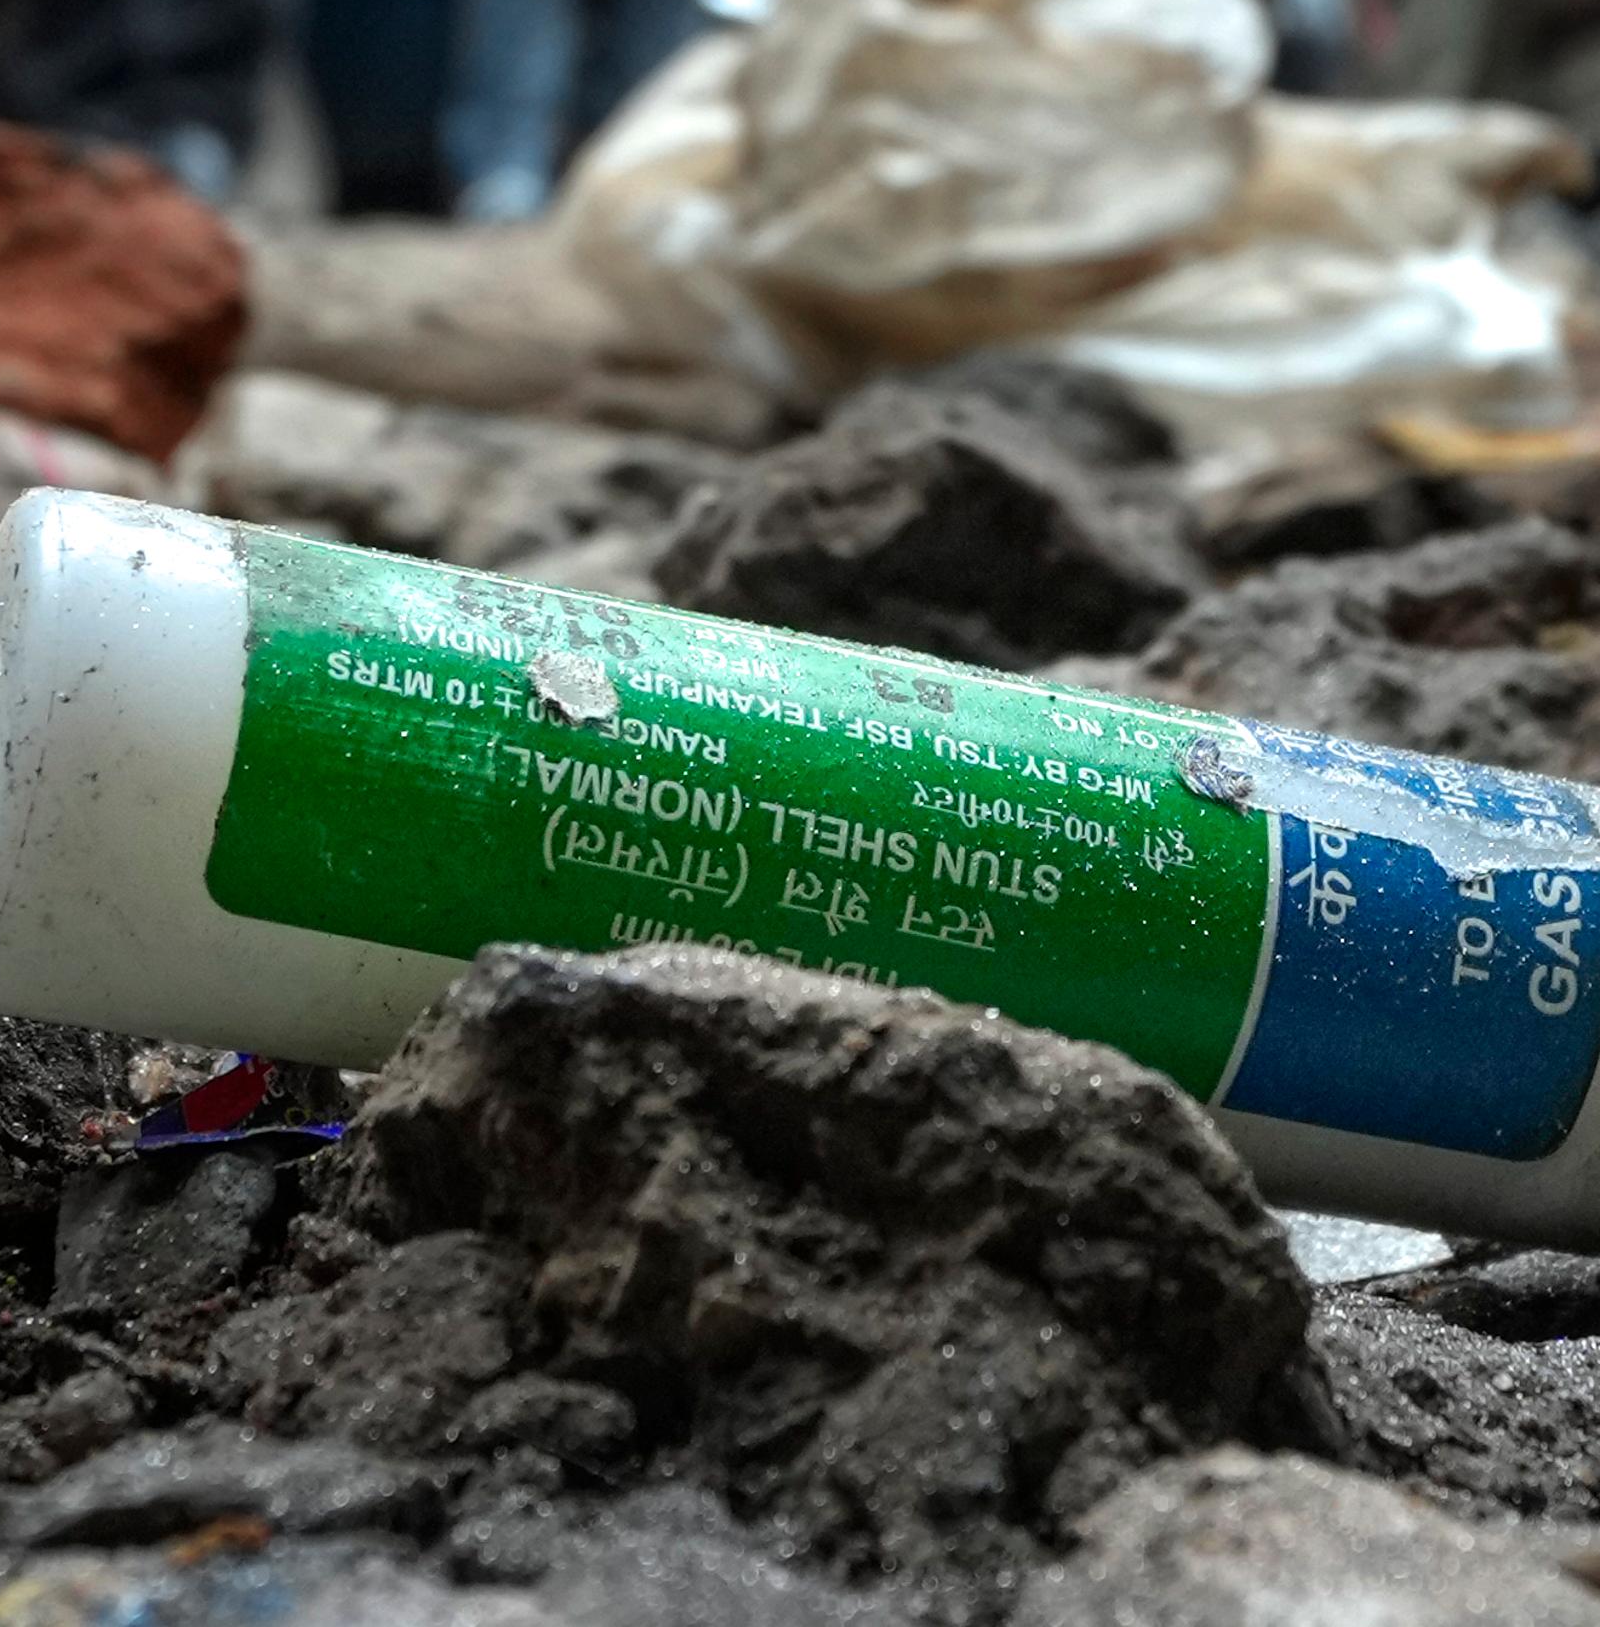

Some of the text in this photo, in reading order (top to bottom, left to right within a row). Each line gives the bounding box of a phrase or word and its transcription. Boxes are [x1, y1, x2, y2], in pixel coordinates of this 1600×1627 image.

[327, 649, 434, 699] MTRS
[446, 678, 485, 709] 10
[617, 660, 828, 732] TEKANPUR,
[527, 695, 586, 730] 00
[838, 709, 913, 751] BSF,
[924, 731, 1002, 771] TSU,
[1078, 767, 1152, 804] MFG
[486, 732, 1062, 904] STUN SHELL (NORMAL)
[1144, 828, 1195, 873] दूरी
[544, 805, 995, 952] स्टन शैल (नॉरमल)
[1453, 917, 1495, 986] TO
[1528, 872, 1582, 1016] GAS
